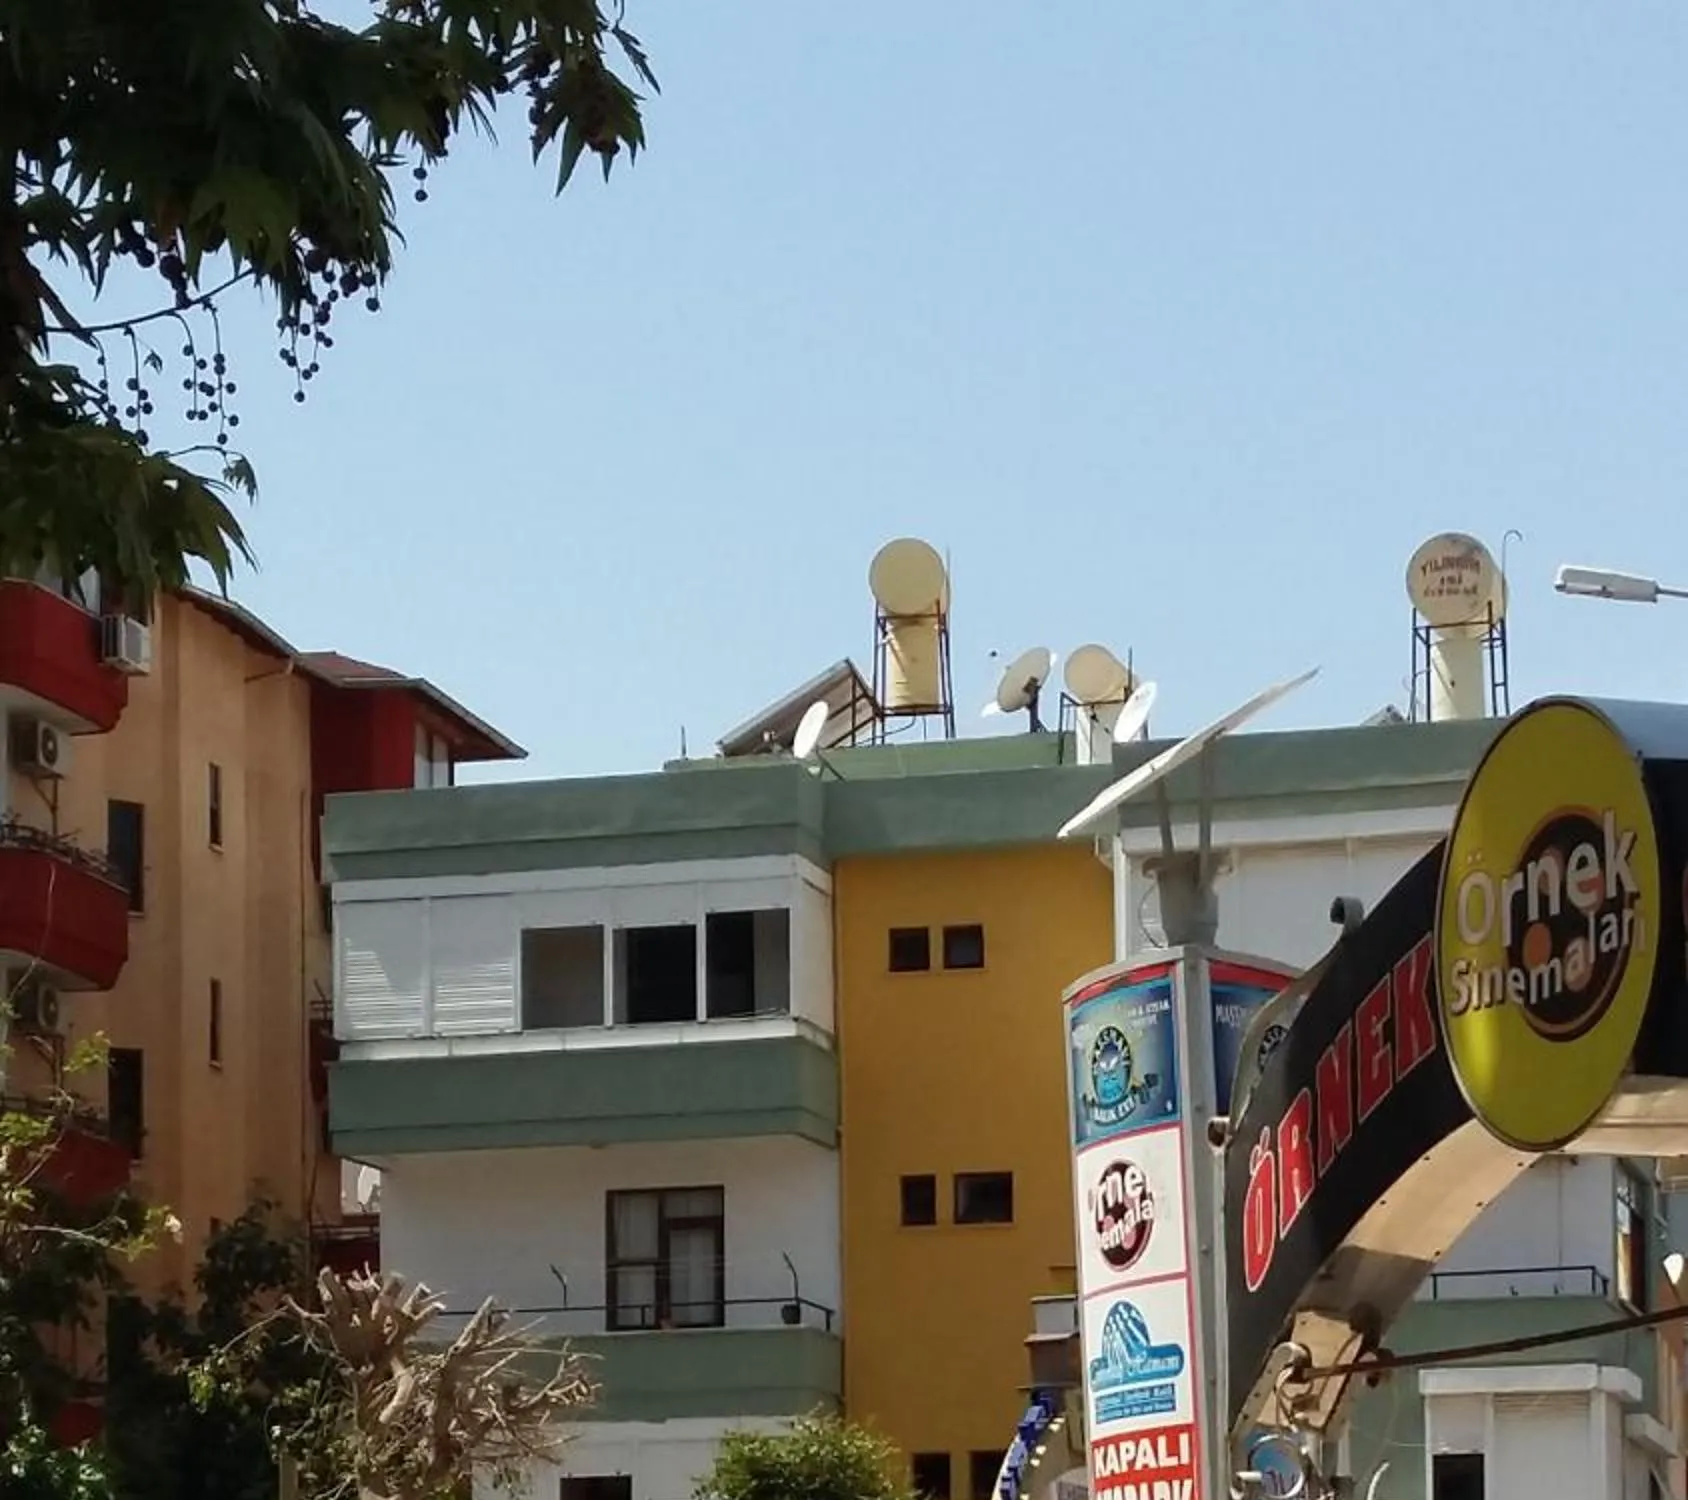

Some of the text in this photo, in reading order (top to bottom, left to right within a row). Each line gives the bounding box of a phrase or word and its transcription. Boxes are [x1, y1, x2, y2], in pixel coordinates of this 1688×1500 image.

[1456, 809, 1639, 947] Örnek
[1450, 907, 1646, 1017] Sinemaları
[1242, 930, 1437, 1293] ÖRNEK
[1093, 1433, 1192, 1479] KAPALI
